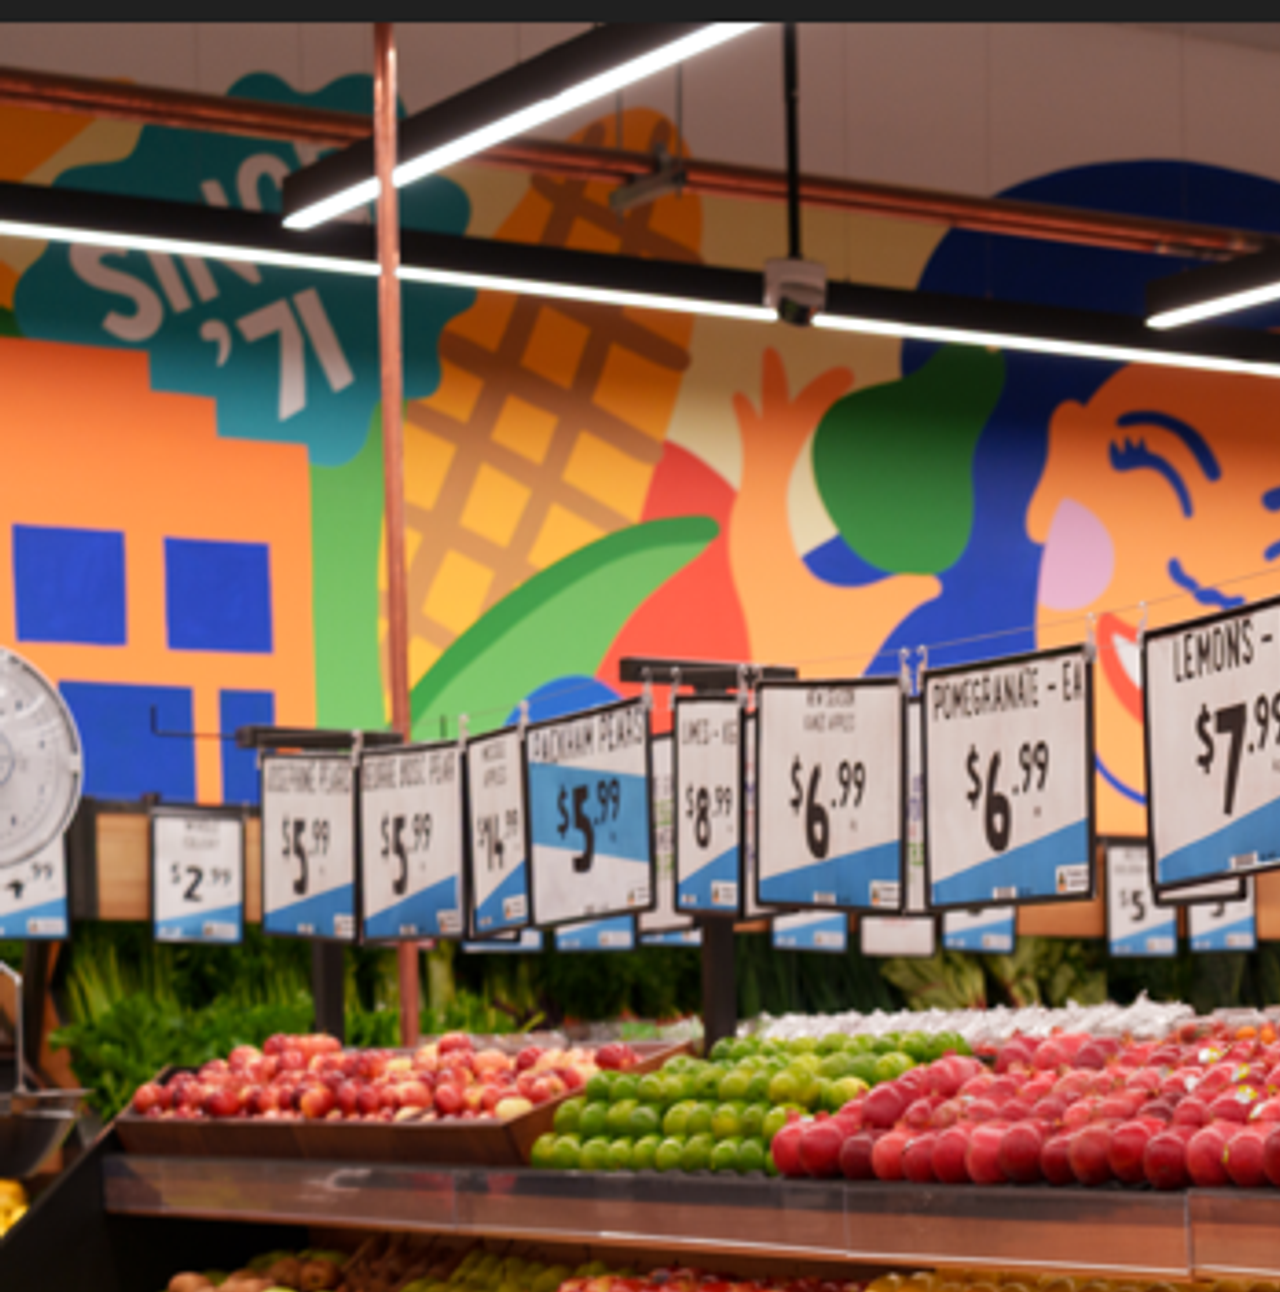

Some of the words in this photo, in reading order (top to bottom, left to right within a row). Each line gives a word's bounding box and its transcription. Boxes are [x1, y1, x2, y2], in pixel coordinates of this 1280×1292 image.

[200, 288, 355, 421] '71
[934, 667, 1038, 721] POMEGRANATE
[1173, 619, 1254, 682] LEMONS
[557, 778, 620, 873] $5.99
[791, 755, 865, 859] $6.99
[967, 741, 1048, 852] $6.99
